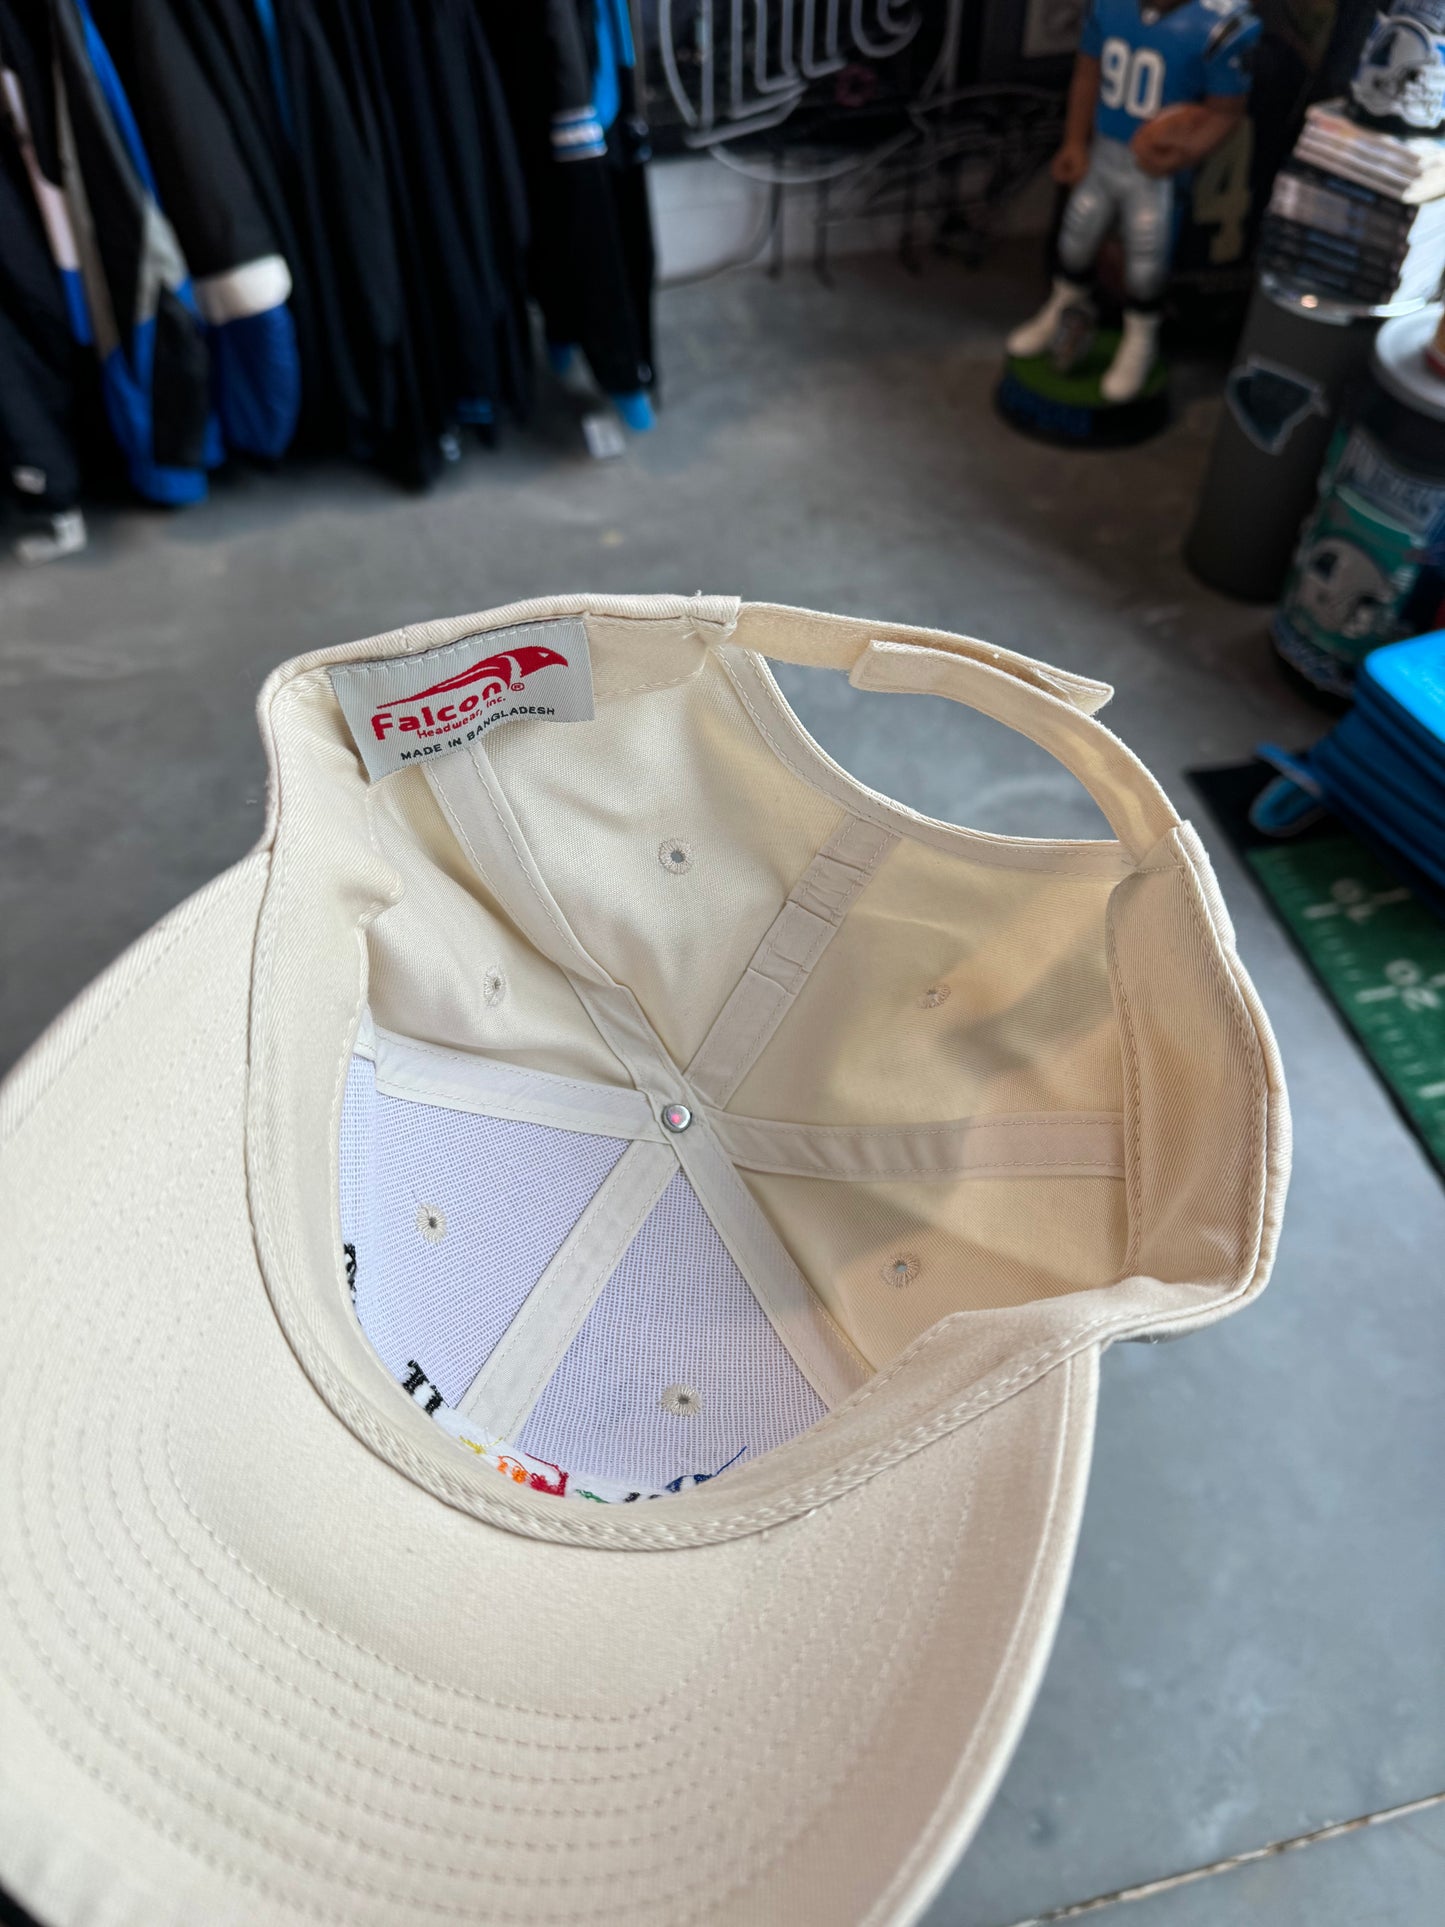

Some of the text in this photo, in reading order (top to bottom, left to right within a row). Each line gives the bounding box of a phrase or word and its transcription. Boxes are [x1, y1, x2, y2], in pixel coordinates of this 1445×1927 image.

[1101, 36, 1166, 119] 90
[371, 681, 502, 741] Falcon
[400, 706, 555, 760] MADE IN BANGLADESH
